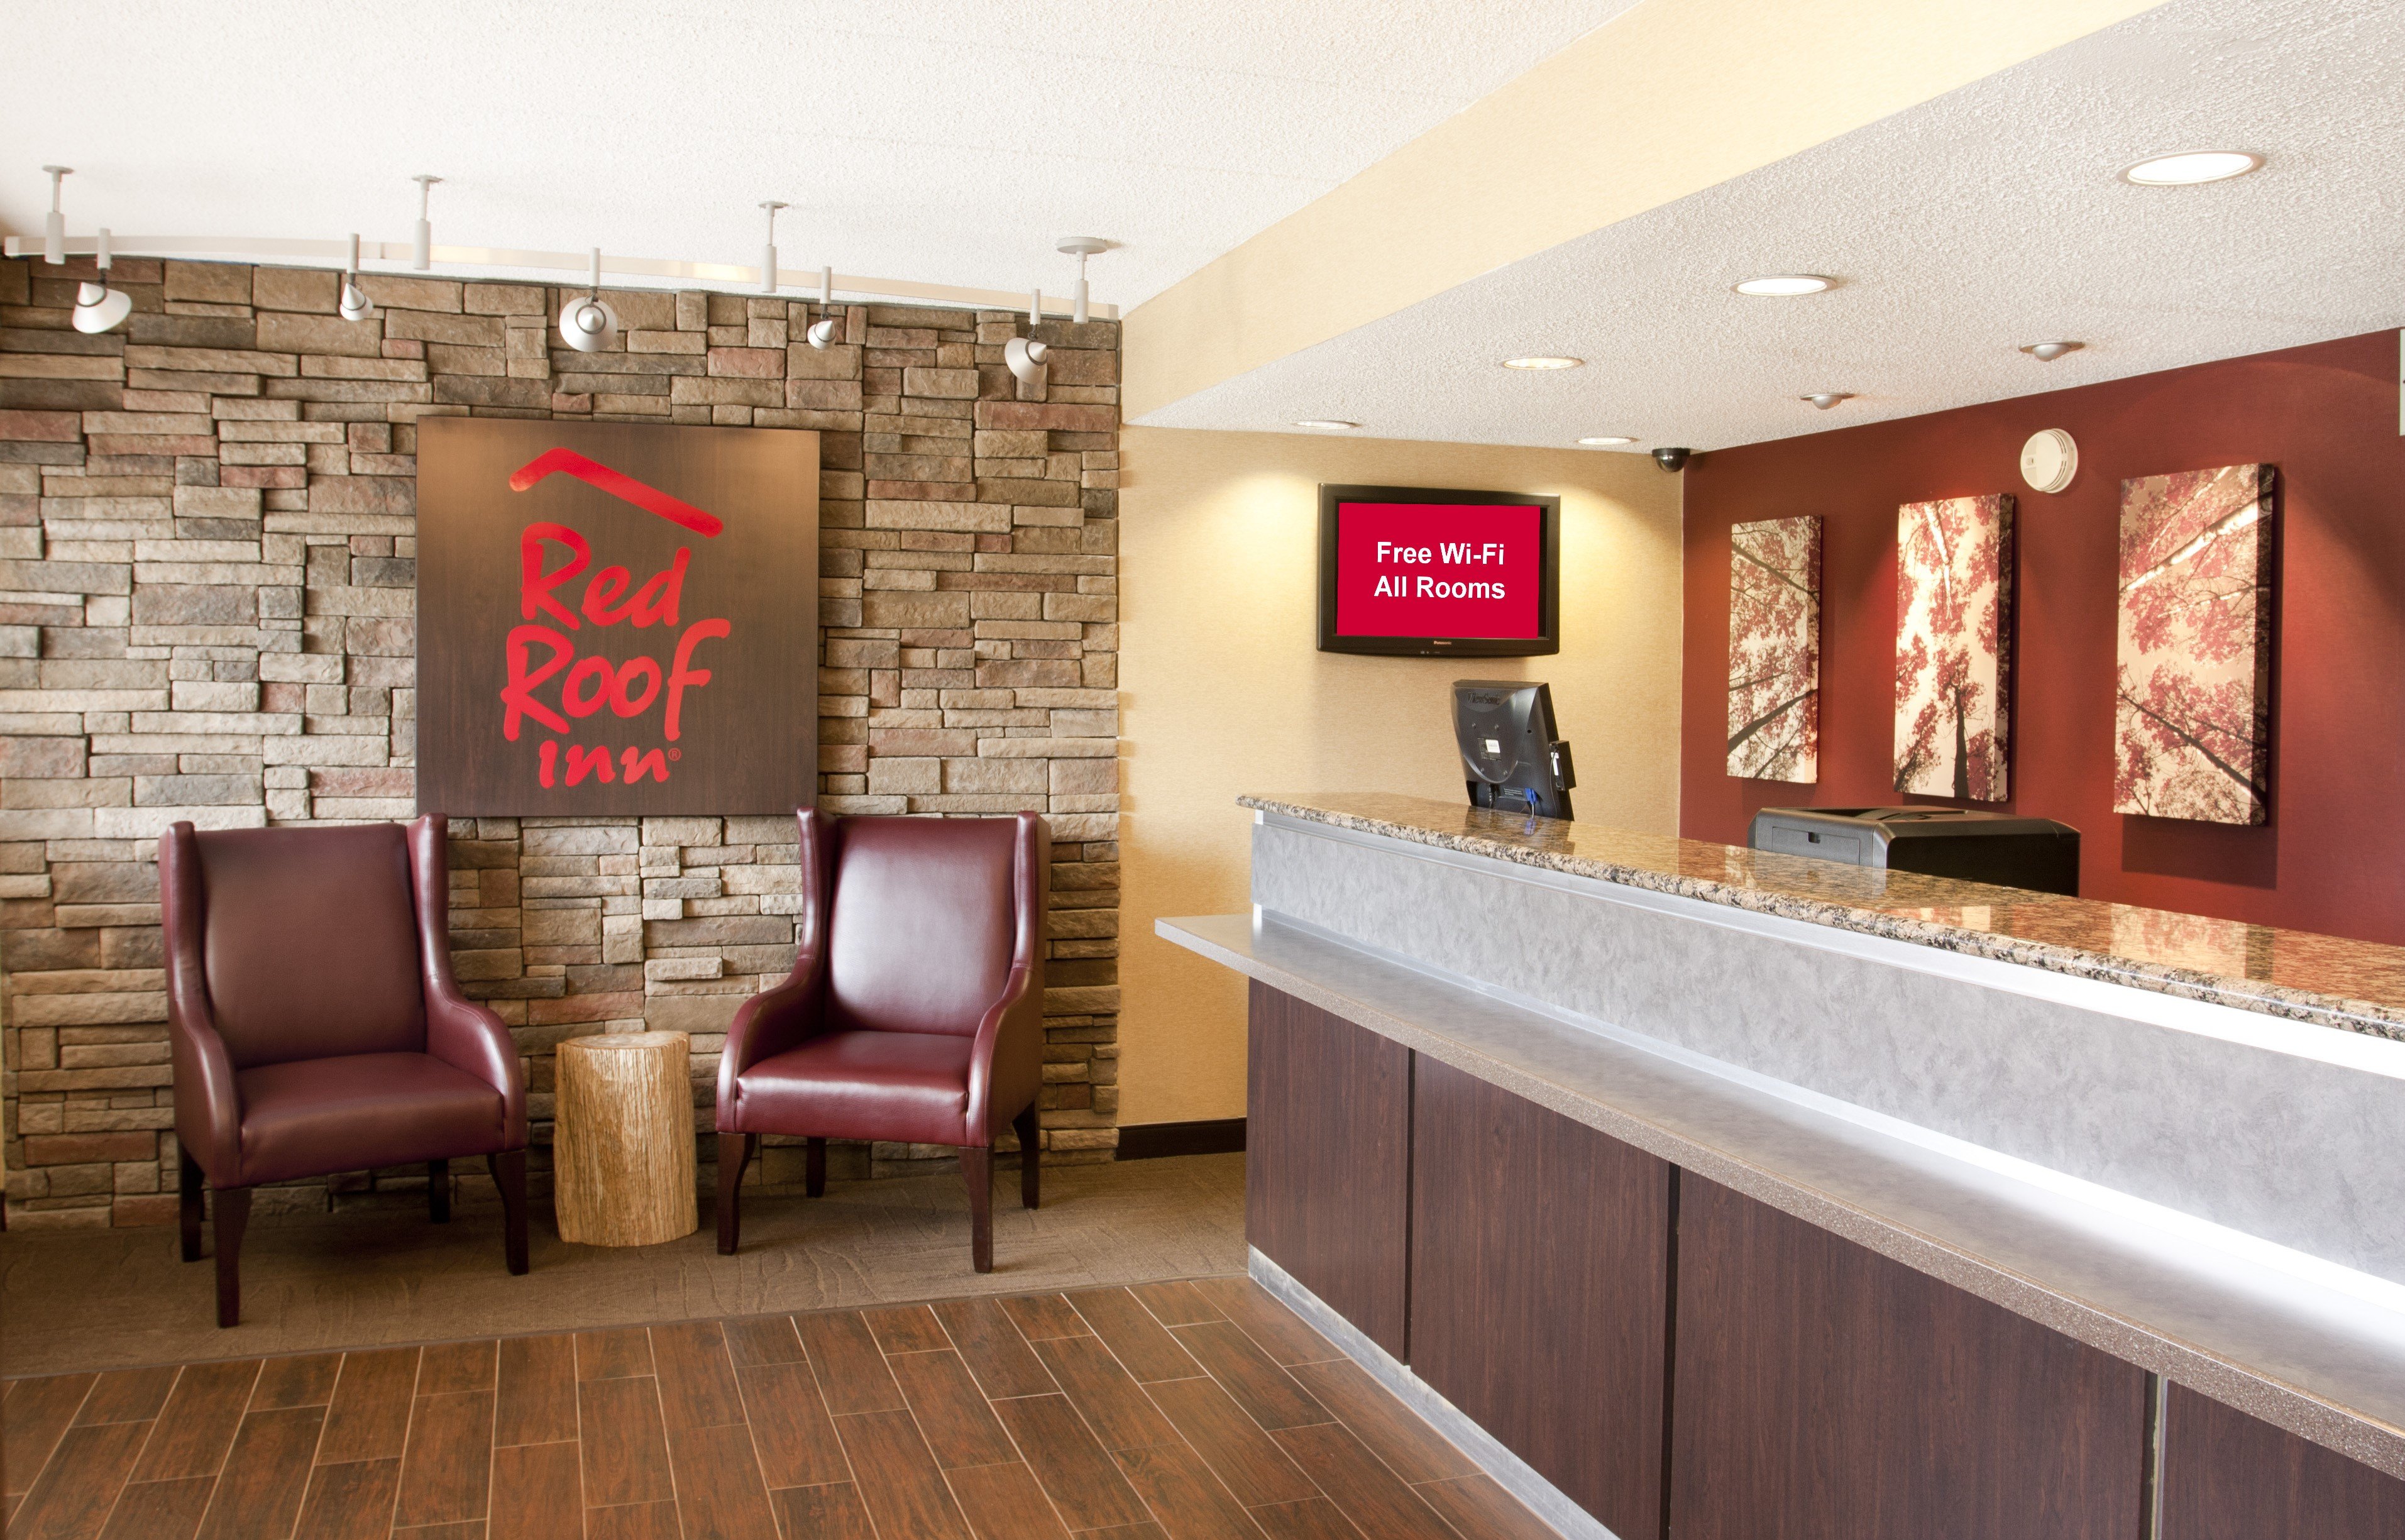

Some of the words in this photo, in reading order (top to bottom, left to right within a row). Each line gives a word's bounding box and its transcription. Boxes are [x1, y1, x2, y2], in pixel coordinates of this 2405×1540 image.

[520, 522, 691, 630] Red
[1377, 541, 1432, 564] Free
[1439, 542, 1504, 565] Wi-Fi
[1373, 575, 1407, 597] All
[1417, 576, 1505, 599] Rooms
[500, 618, 731, 742] Roof
